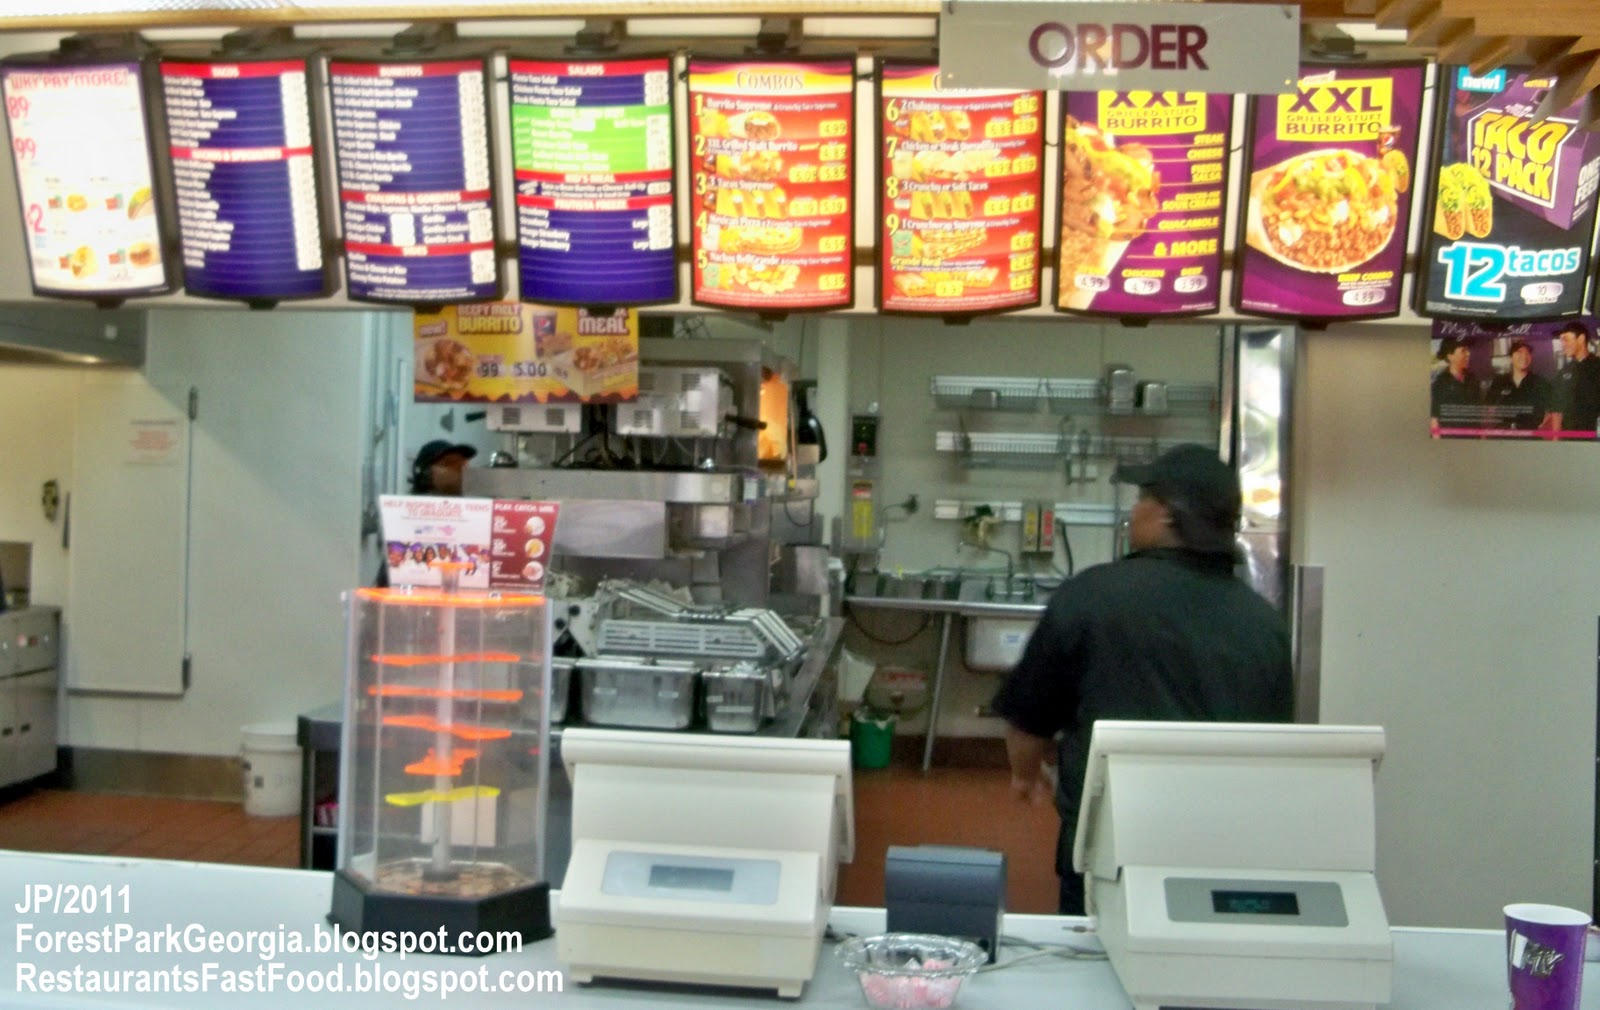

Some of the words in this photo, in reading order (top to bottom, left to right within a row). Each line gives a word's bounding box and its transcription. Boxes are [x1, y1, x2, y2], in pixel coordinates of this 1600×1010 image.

[1028, 22, 1209, 71] ORDER
[11, 75, 42, 89] WHY
[43, 73, 71, 88] PAY
[73, 69, 130, 87] MORE!
[567, 65, 604, 76] SALADS
[695, 94, 704, 116] 1
[707, 98, 735, 109] Burrito
[1107, 90, 1197, 108] XXL
[1288, 87, 1382, 113] XXL
[886, 98, 899, 121] 6
[1107, 108, 1160, 117] GRILLED
[1164, 108, 1197, 116] STUFT
[1286, 114, 1342, 122] GRILLED
[1346, 113, 1382, 121] STUFT
[1107, 116, 1197, 129] BURRITO
[1286, 122, 1382, 135] BURRITO
[695, 135, 705, 155] 2
[886, 137, 898, 158] 7
[1474, 112, 1569, 165] TACO
[696, 173, 707, 194] 3
[1472, 147, 1492, 178] 12
[1496, 153, 1553, 200] PACK
[886, 177, 898, 198] 8
[909, 182, 940, 194] Crunchy
[968, 181, 988, 190] Tacos
[696, 212, 707, 233] 4
[886, 214, 899, 236] 9
[1154, 242, 1167, 257] &
[1171, 239, 1217, 256] MORE
[697, 250, 708, 269] 5
[1438, 242, 1506, 302] 12
[1506, 246, 1581, 276] tacos
[459, 316, 521, 333] BURRITO
[579, 317, 628, 334] MEAL
